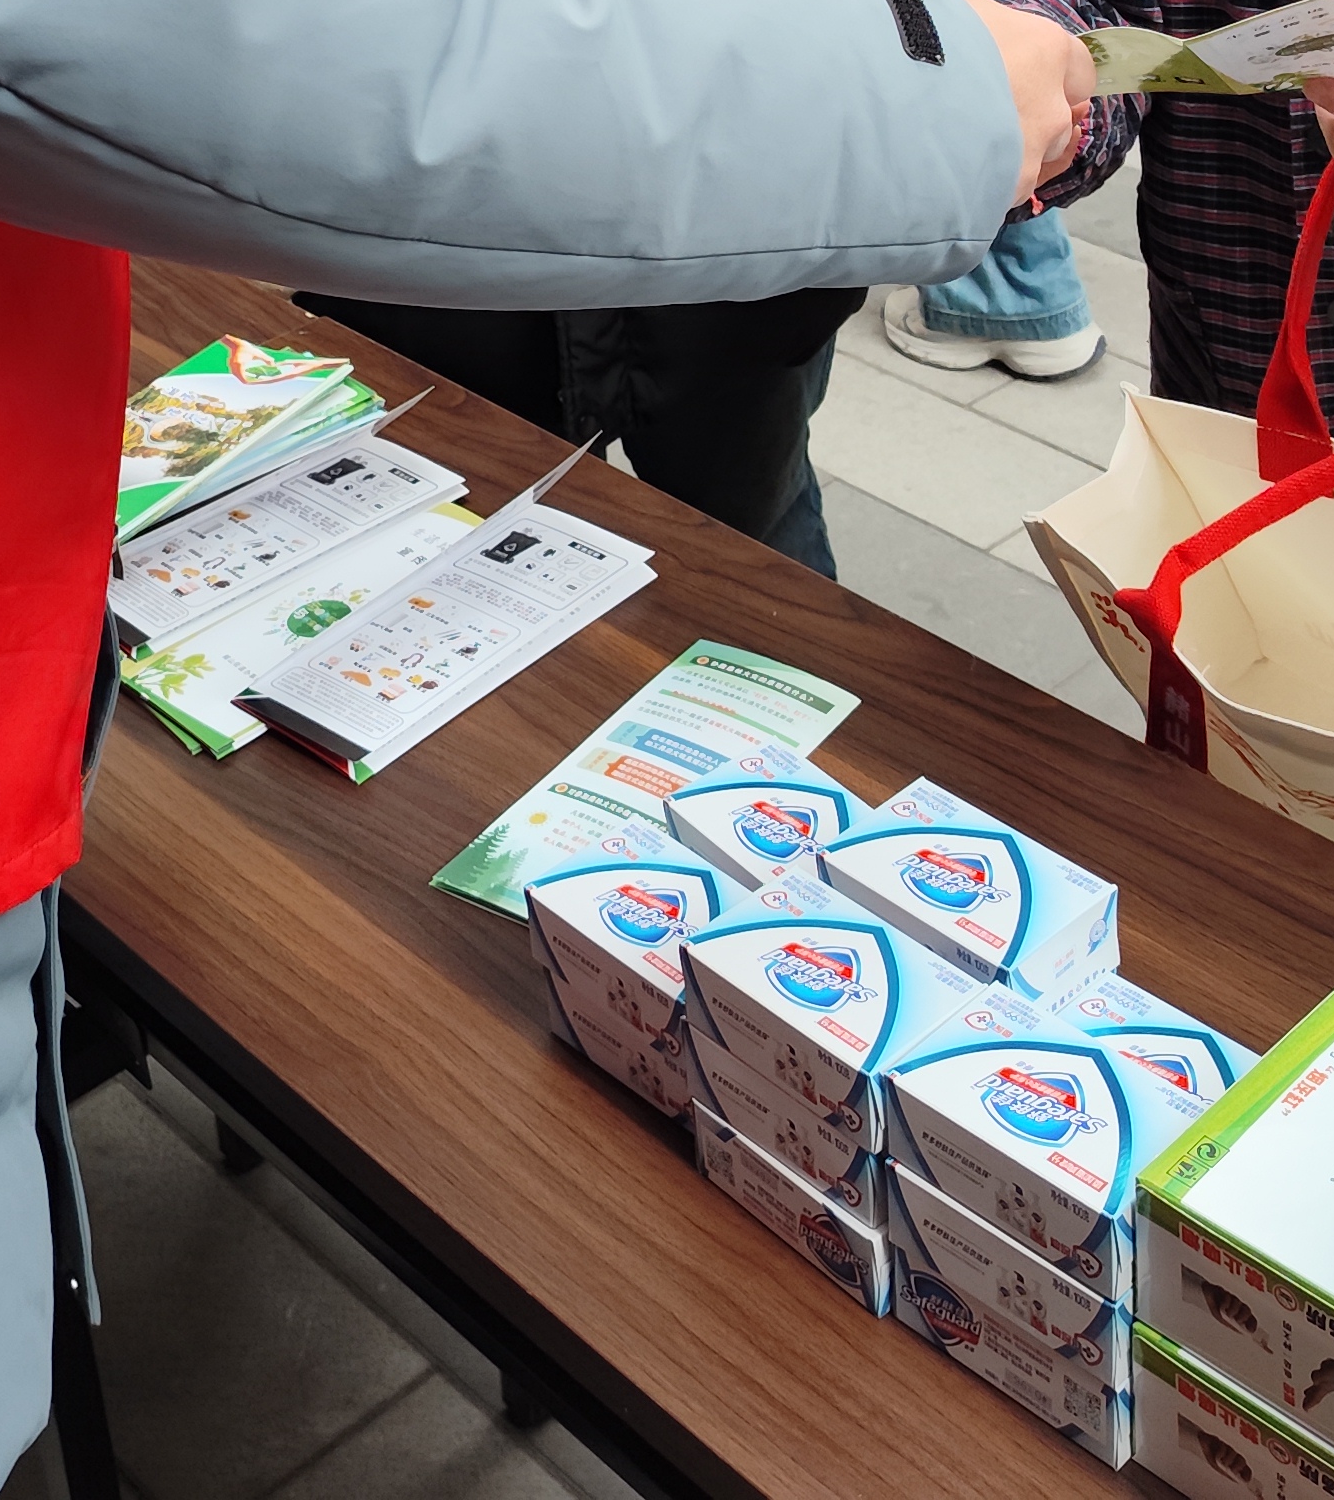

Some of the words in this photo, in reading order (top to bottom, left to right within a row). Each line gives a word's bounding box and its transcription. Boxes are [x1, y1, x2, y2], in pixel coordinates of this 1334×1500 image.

[730, 804, 822, 856] Safeguard
[894, 851, 1010, 906] Safeguard
[595, 887, 698, 941] Safeguard
[761, 946, 878, 1006] Safeguard
[975, 1073, 1106, 1136] Safeguard
[989, 1089, 1050, 1124] 舒肤佳
[797, 1223, 870, 1273] Safeguard
[1176, 1222, 1267, 1292] 禁止吸烟
[898, 1285, 984, 1338] Safeguard
